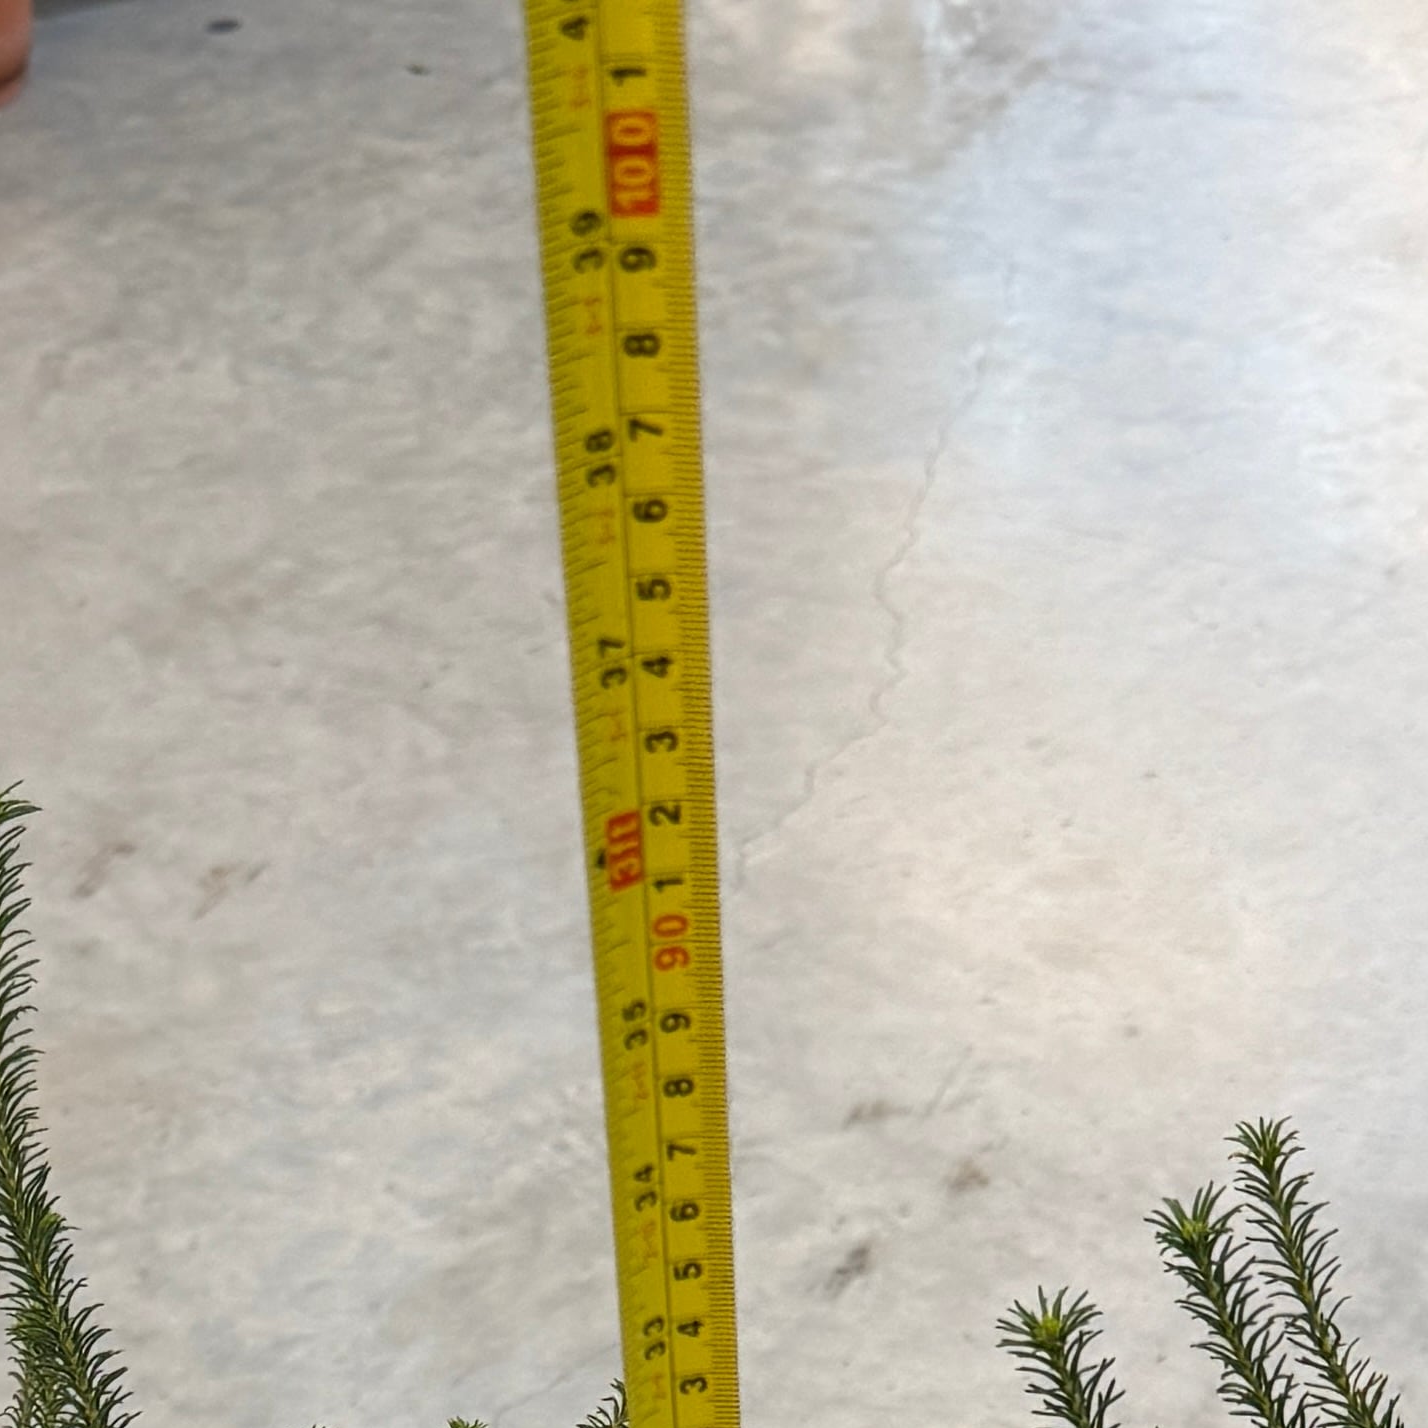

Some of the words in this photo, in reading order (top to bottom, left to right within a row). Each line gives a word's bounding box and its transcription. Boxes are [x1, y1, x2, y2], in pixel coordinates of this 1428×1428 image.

[609, 66, 648, 87] 1
[570, 209, 605, 272] 39
[617, 245, 658, 274] 9
[620, 330, 661, 358] 8
[627, 418, 664, 442] 7
[584, 428, 617, 488] 38
[630, 496, 669, 524] 6
[634, 572, 672, 602] 5
[596, 636, 629, 690] 37
[640, 654, 674, 679] 4
[642, 725, 679, 754] 3
[647, 800, 682, 827] 2
[650, 874, 685, 894] 1
[651, 914, 691, 972] 90
[621, 999, 649, 1051] 35
[658, 1008, 692, 1034] 9
[662, 1073, 695, 1099] 8
[665, 1138, 698, 1162] 7
[632, 1163, 658, 1212] 34
[668, 1198, 701, 1223] 6
[672, 1258, 703, 1282] 5
[642, 1315, 666, 1361] 33
[675, 1317, 704, 1338] 4
[678, 1373, 708, 1395] 3
